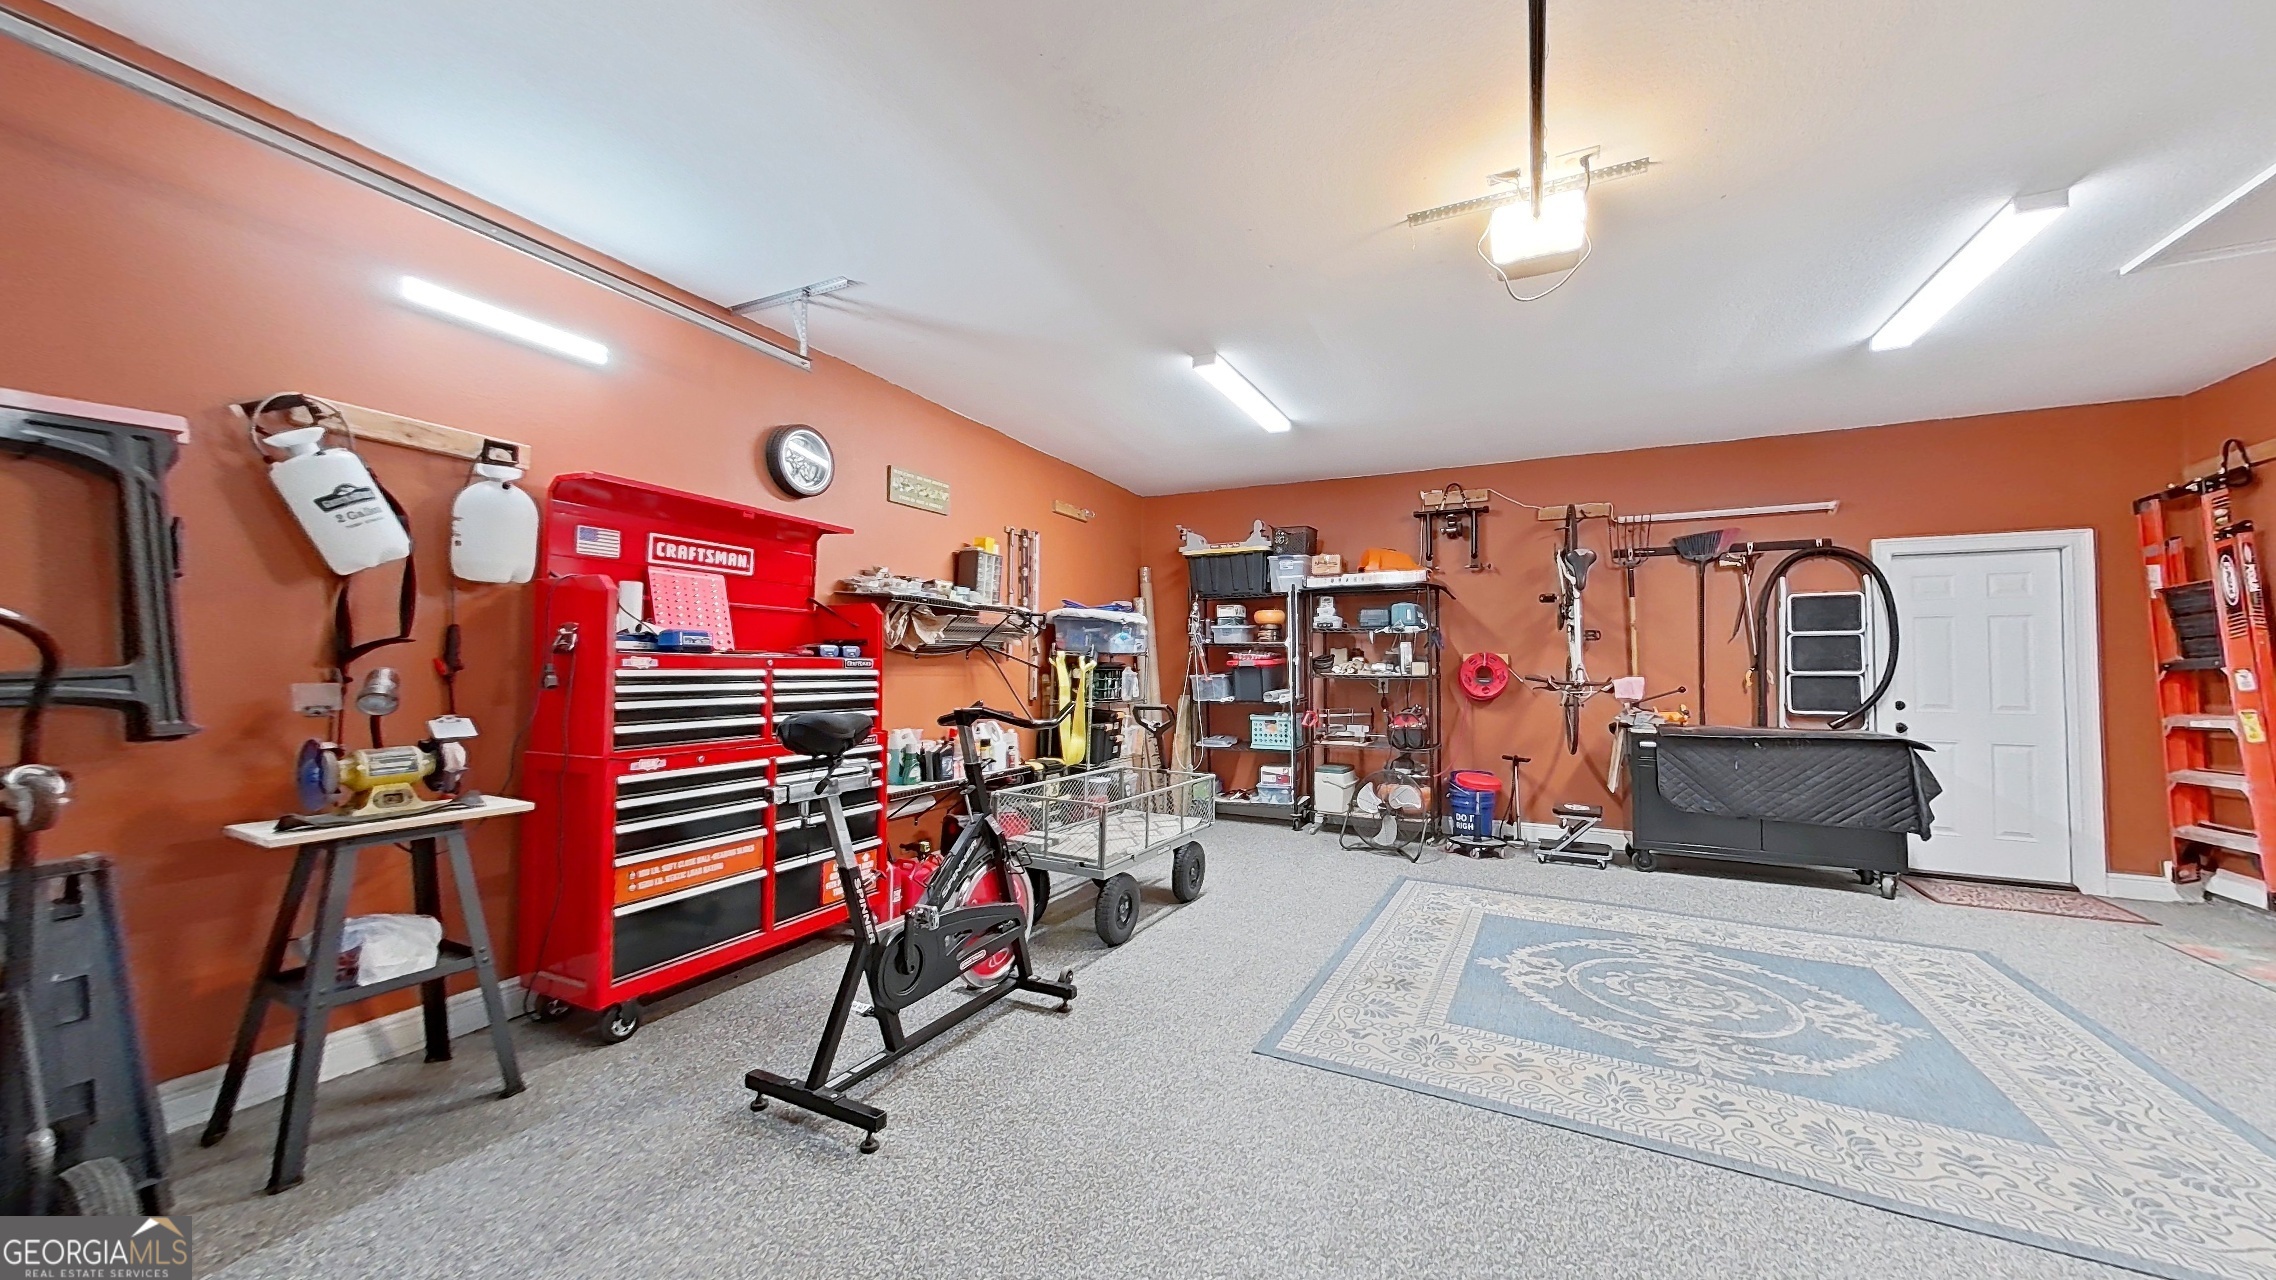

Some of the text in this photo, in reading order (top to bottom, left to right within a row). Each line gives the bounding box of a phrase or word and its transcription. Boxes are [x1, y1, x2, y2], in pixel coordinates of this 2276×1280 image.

[656, 541, 750, 568] CRAFTSMAN
[1455, 812, 1467, 822] DO
[1455, 821, 1475, 831] RIGH
[854, 877, 876, 945] SPINNER
